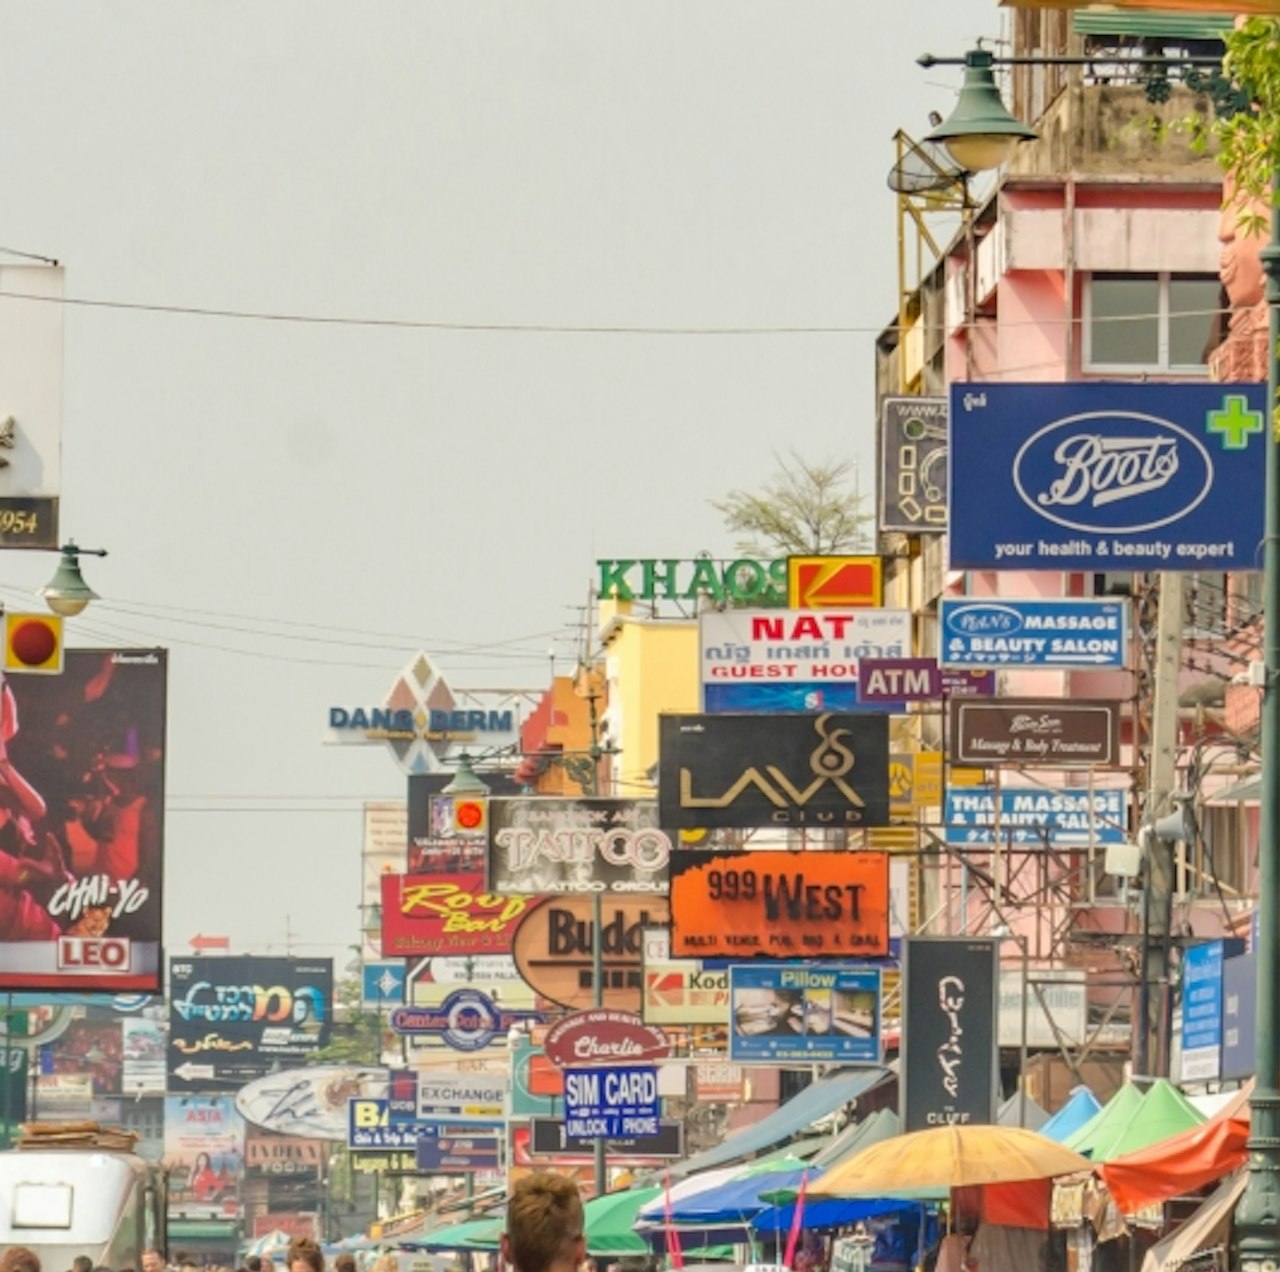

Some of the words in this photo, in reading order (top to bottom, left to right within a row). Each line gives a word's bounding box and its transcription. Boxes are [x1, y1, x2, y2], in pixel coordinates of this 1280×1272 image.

[1038, 433, 1180, 509] Boots
[994, 542, 1035, 560] your
[1038, 539, 1093, 557] health
[1095, 540, 1110, 557] &
[1113, 540, 1172, 560] beauty
[1176, 540, 1235, 560] expert
[752, 615, 855, 642] NAT
[1024, 615, 1118, 631] MASSAGE
[948, 637, 966, 652] &
[970, 637, 1048, 653] BEAUTY
[1050, 638, 1119, 654] SALON
[711, 664, 799, 679] GUEST
[867, 668, 931, 696] ATM
[428, 708, 513, 732] DERM
[494, 827, 673, 874] TATTOO
[706, 869, 757, 900] 999
[442, 910, 507, 933] Bar
[62, 939, 127, 968] LEO
[780, 971, 837, 988] Pillow
[573, 1035, 644, 1058] Charlie
[421, 1087, 504, 1101] EXCHANGE
[566, 1073, 599, 1107] SIM
[604, 1071, 657, 1106] CARD
[567, 1118, 608, 1137] UNLOCK
[621, 1116, 658, 1135] PHONE
